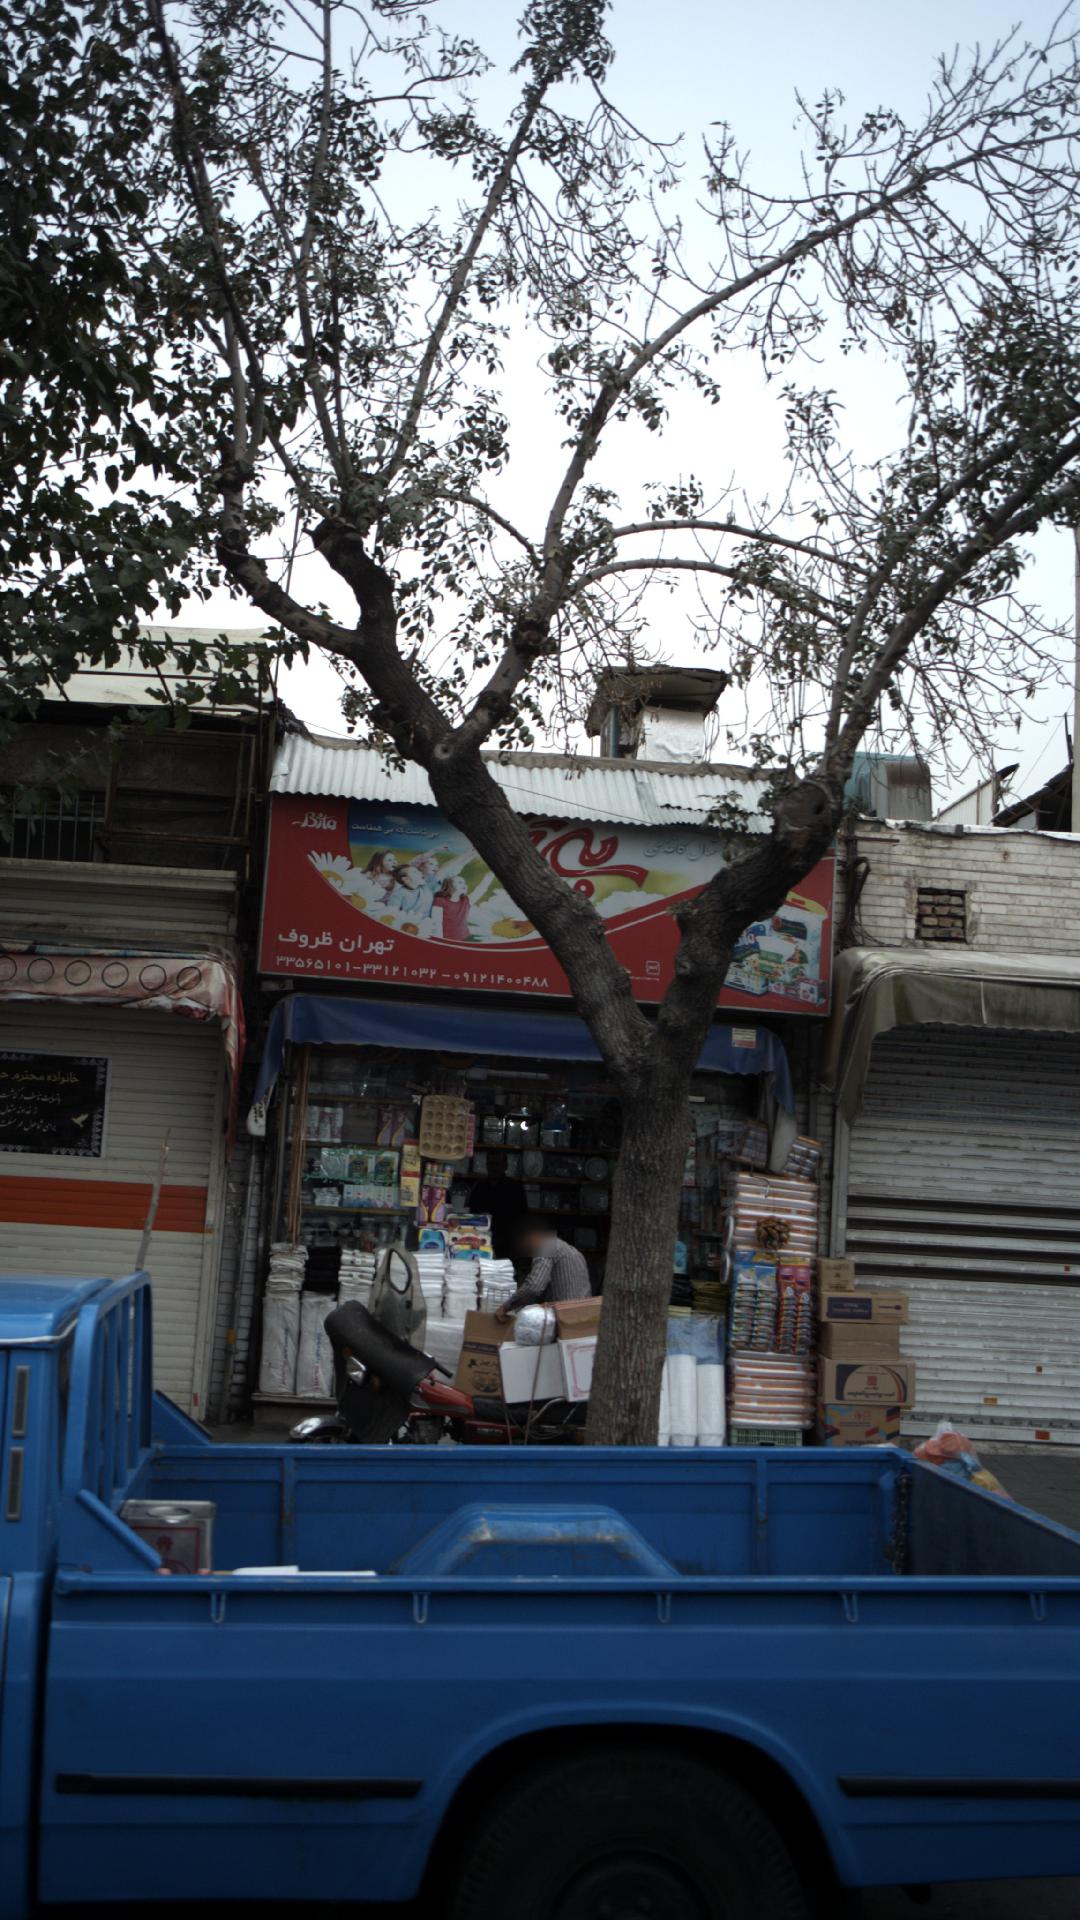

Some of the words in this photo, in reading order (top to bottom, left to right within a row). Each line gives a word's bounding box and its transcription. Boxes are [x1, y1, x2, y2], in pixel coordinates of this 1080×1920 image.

[291, 811, 337, 831] Bita
[277, 928, 334, 949] ظروف
[338, 934, 395, 955] تهران
[452, 971, 550, 988] ۰۹۱۲۱۴۰۰۴۸۸
[47, 1070, 80, 1085] خانواده
